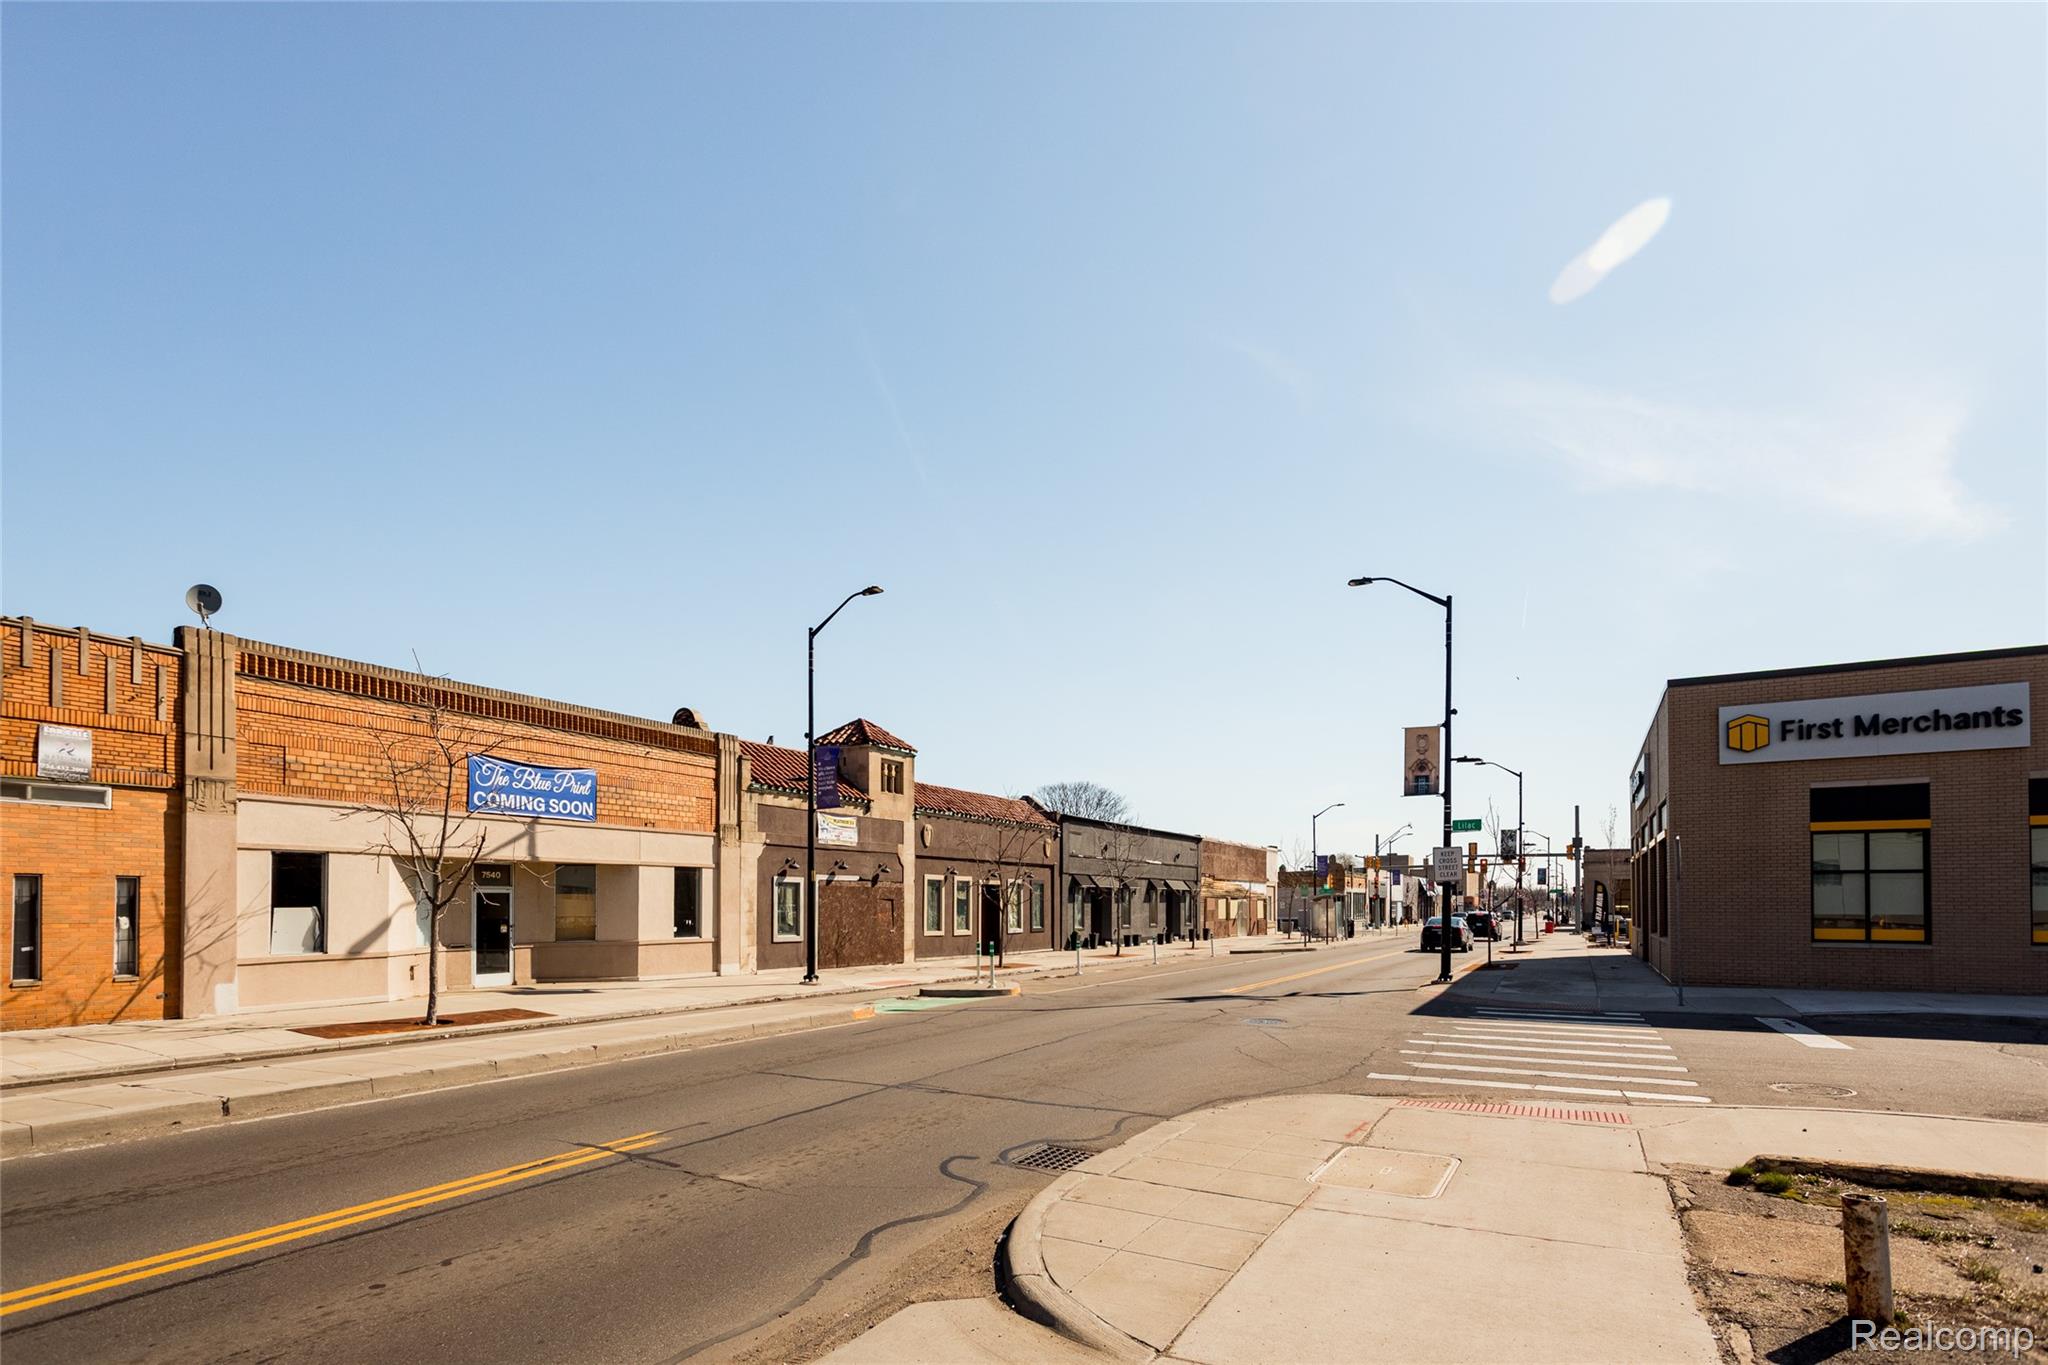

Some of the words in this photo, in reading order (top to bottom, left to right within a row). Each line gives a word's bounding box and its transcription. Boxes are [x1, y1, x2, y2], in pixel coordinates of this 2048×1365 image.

[1779, 717, 1844, 742] First
[1853, 704, 2025, 738] Merchants
[475, 763, 511, 787] The
[512, 766, 553, 791] Blue
[553, 771, 592, 796] Print
[473, 791, 545, 812] COMING
[548, 799, 594, 816] SOON
[1458, 821, 1476, 830] Lilac
[481, 870, 501, 879] 7540
